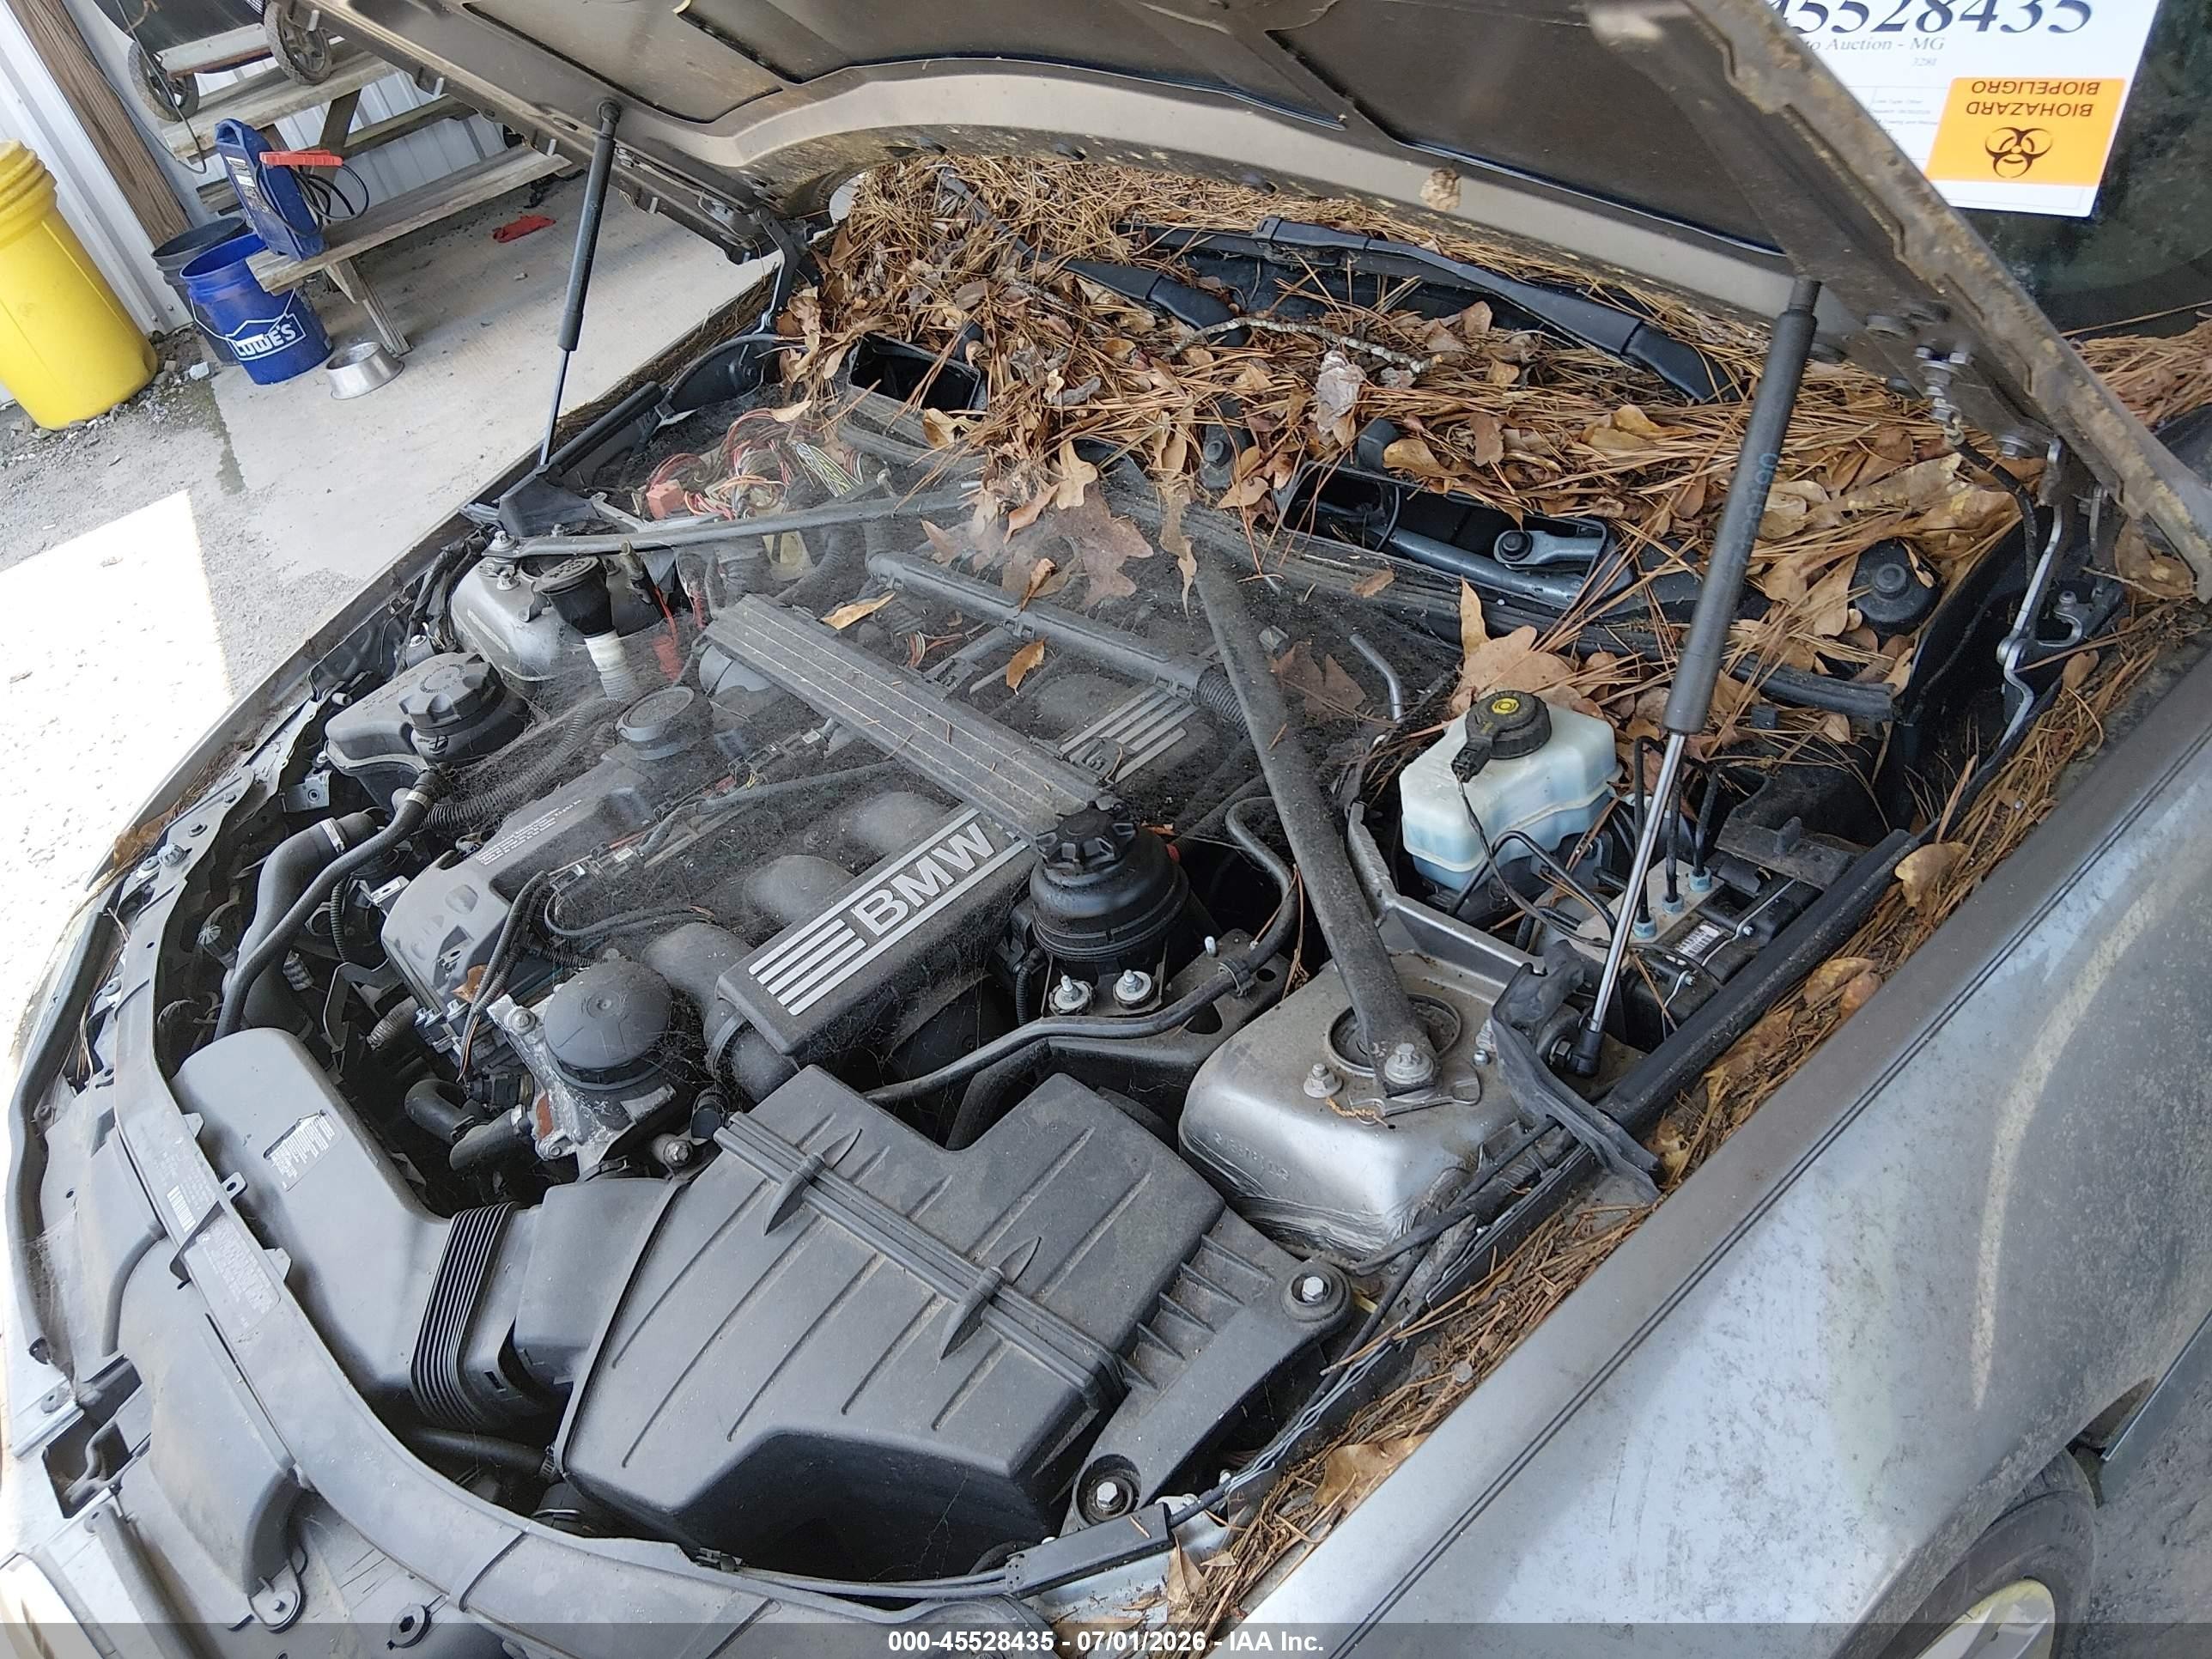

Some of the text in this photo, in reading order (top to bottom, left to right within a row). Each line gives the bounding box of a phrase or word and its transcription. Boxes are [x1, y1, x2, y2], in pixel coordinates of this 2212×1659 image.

[1826, 37, 1893, 51] Auction
[1910, 37, 1945, 51] MG
[1972, 81, 2100, 95] BIOPELIGRO
[1966, 101, 2094, 117] BIOHAZARD
[233, 323, 295, 356] LOWE'S
[850, 822, 996, 937] BMW
